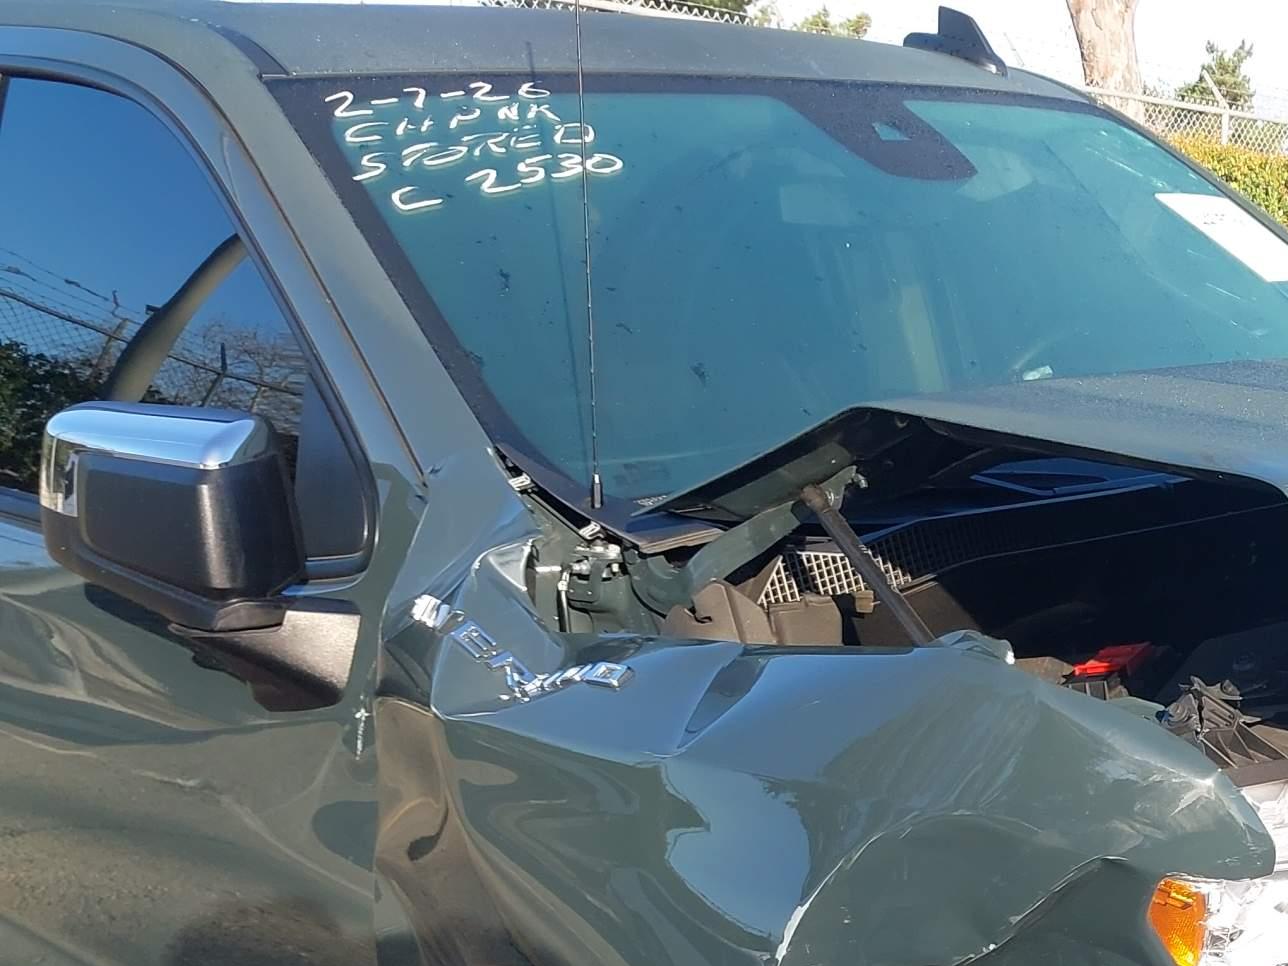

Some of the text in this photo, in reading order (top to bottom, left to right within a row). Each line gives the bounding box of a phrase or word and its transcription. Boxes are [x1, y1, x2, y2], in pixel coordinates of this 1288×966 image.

[324, 81, 551, 118] 2-7-26
[352, 122, 596, 181] STORED
[464, 152, 624, 194] 2530
